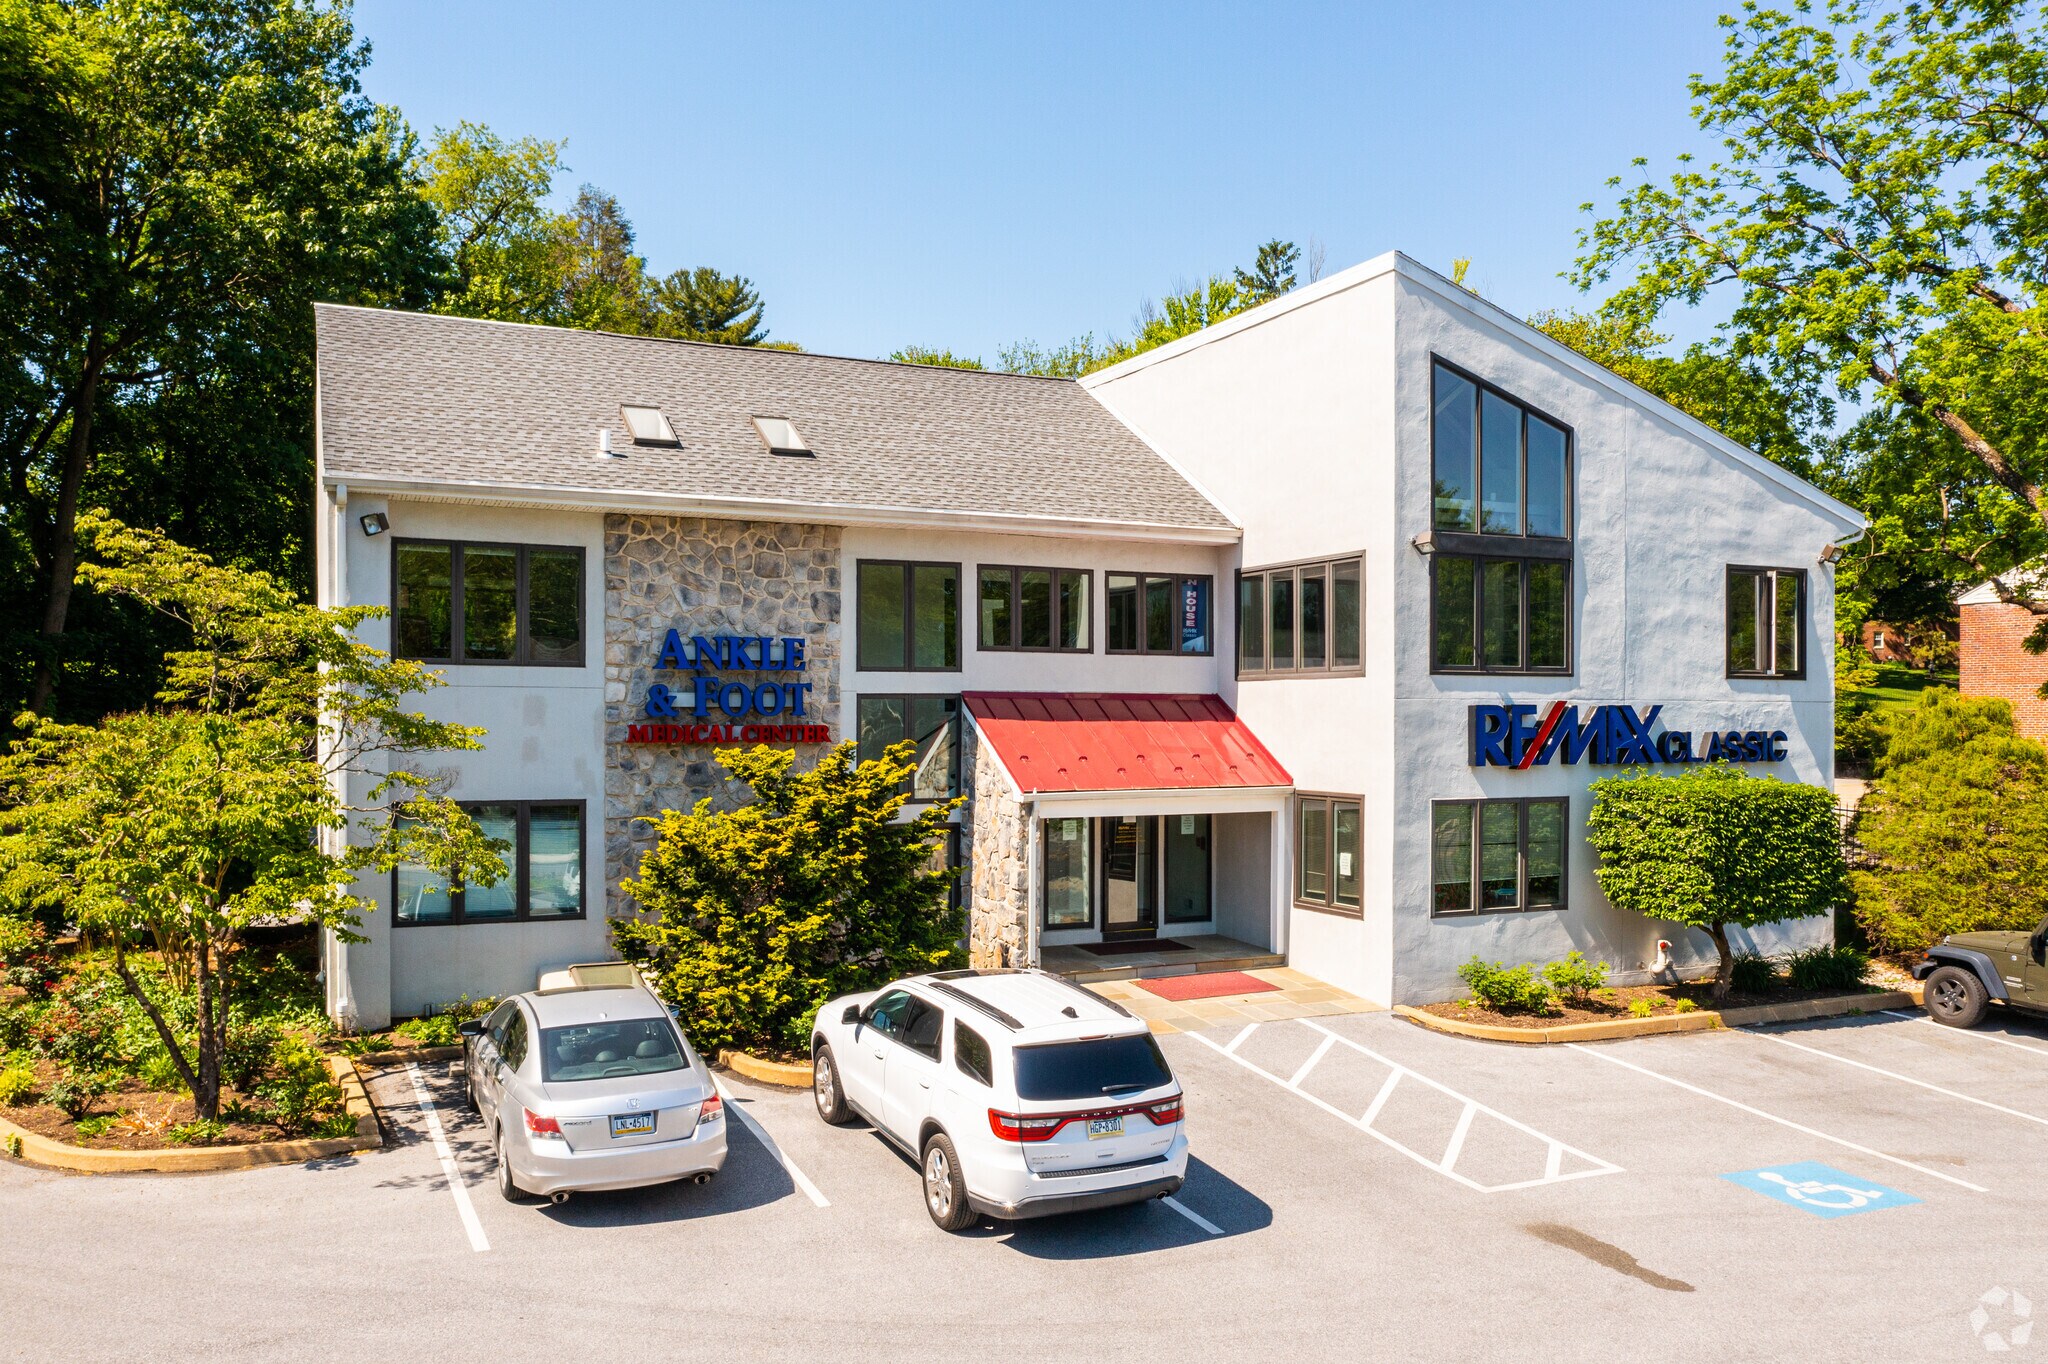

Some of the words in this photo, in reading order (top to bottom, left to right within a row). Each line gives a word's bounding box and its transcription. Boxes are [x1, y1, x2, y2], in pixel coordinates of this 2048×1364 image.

[1186, 590, 1197, 627] HOUSE
[652, 628, 806, 671] ANKLE
[645, 684, 679, 717] &
[691, 676, 812, 717] FOOT
[626, 724, 739, 743] MEDICAL
[741, 724, 832, 743] CENTER
[1470, 701, 1663, 769] RE/MAX
[1661, 730, 1788, 763] CLASSIC
